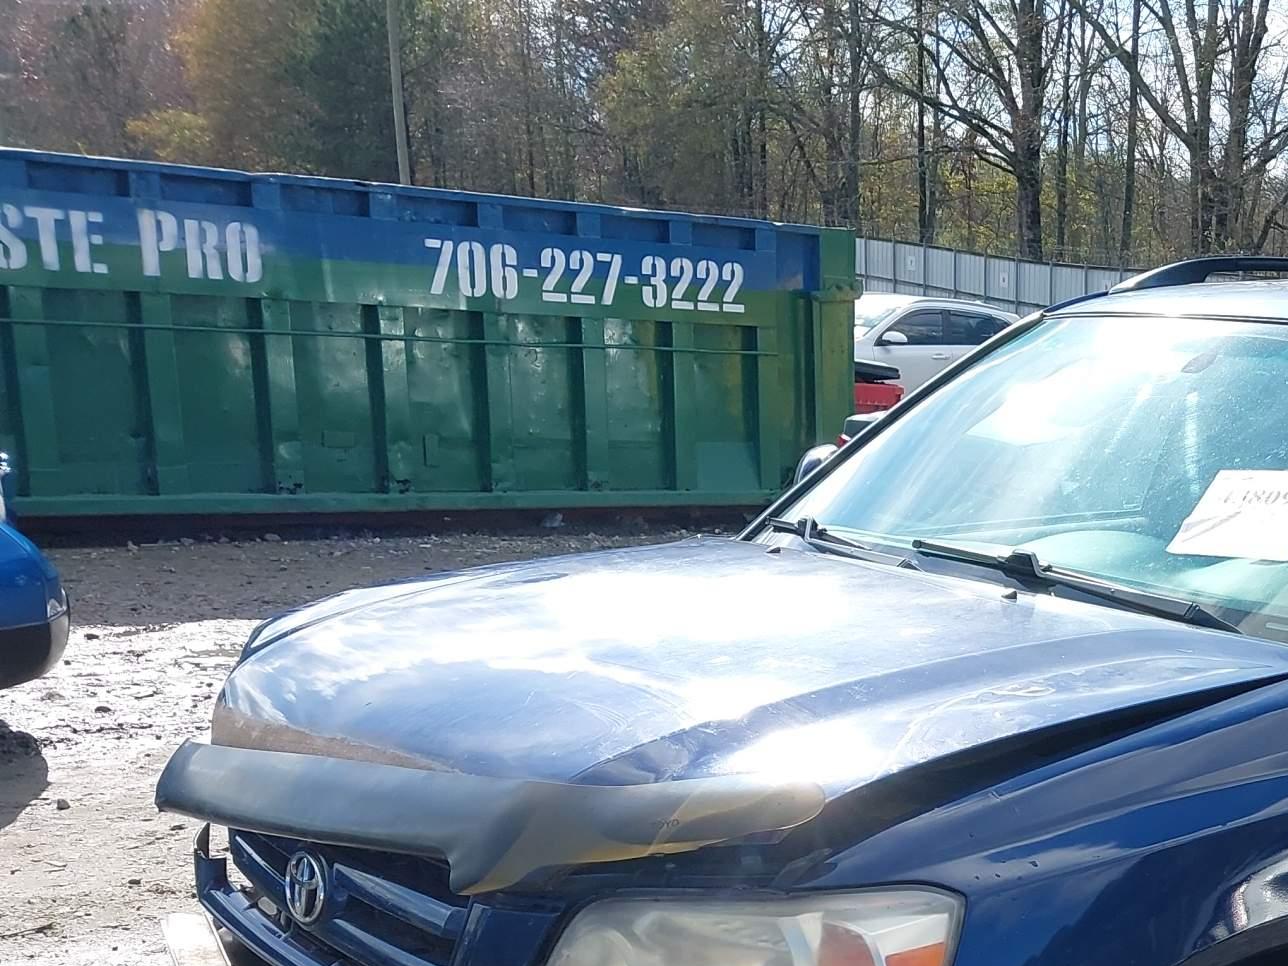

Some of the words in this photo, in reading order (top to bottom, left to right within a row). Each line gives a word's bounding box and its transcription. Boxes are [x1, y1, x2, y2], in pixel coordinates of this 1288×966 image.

[0, 203, 109, 275] STE
[136, 207, 263, 284] PRO
[424, 238, 745, 313] 706-227-3222
